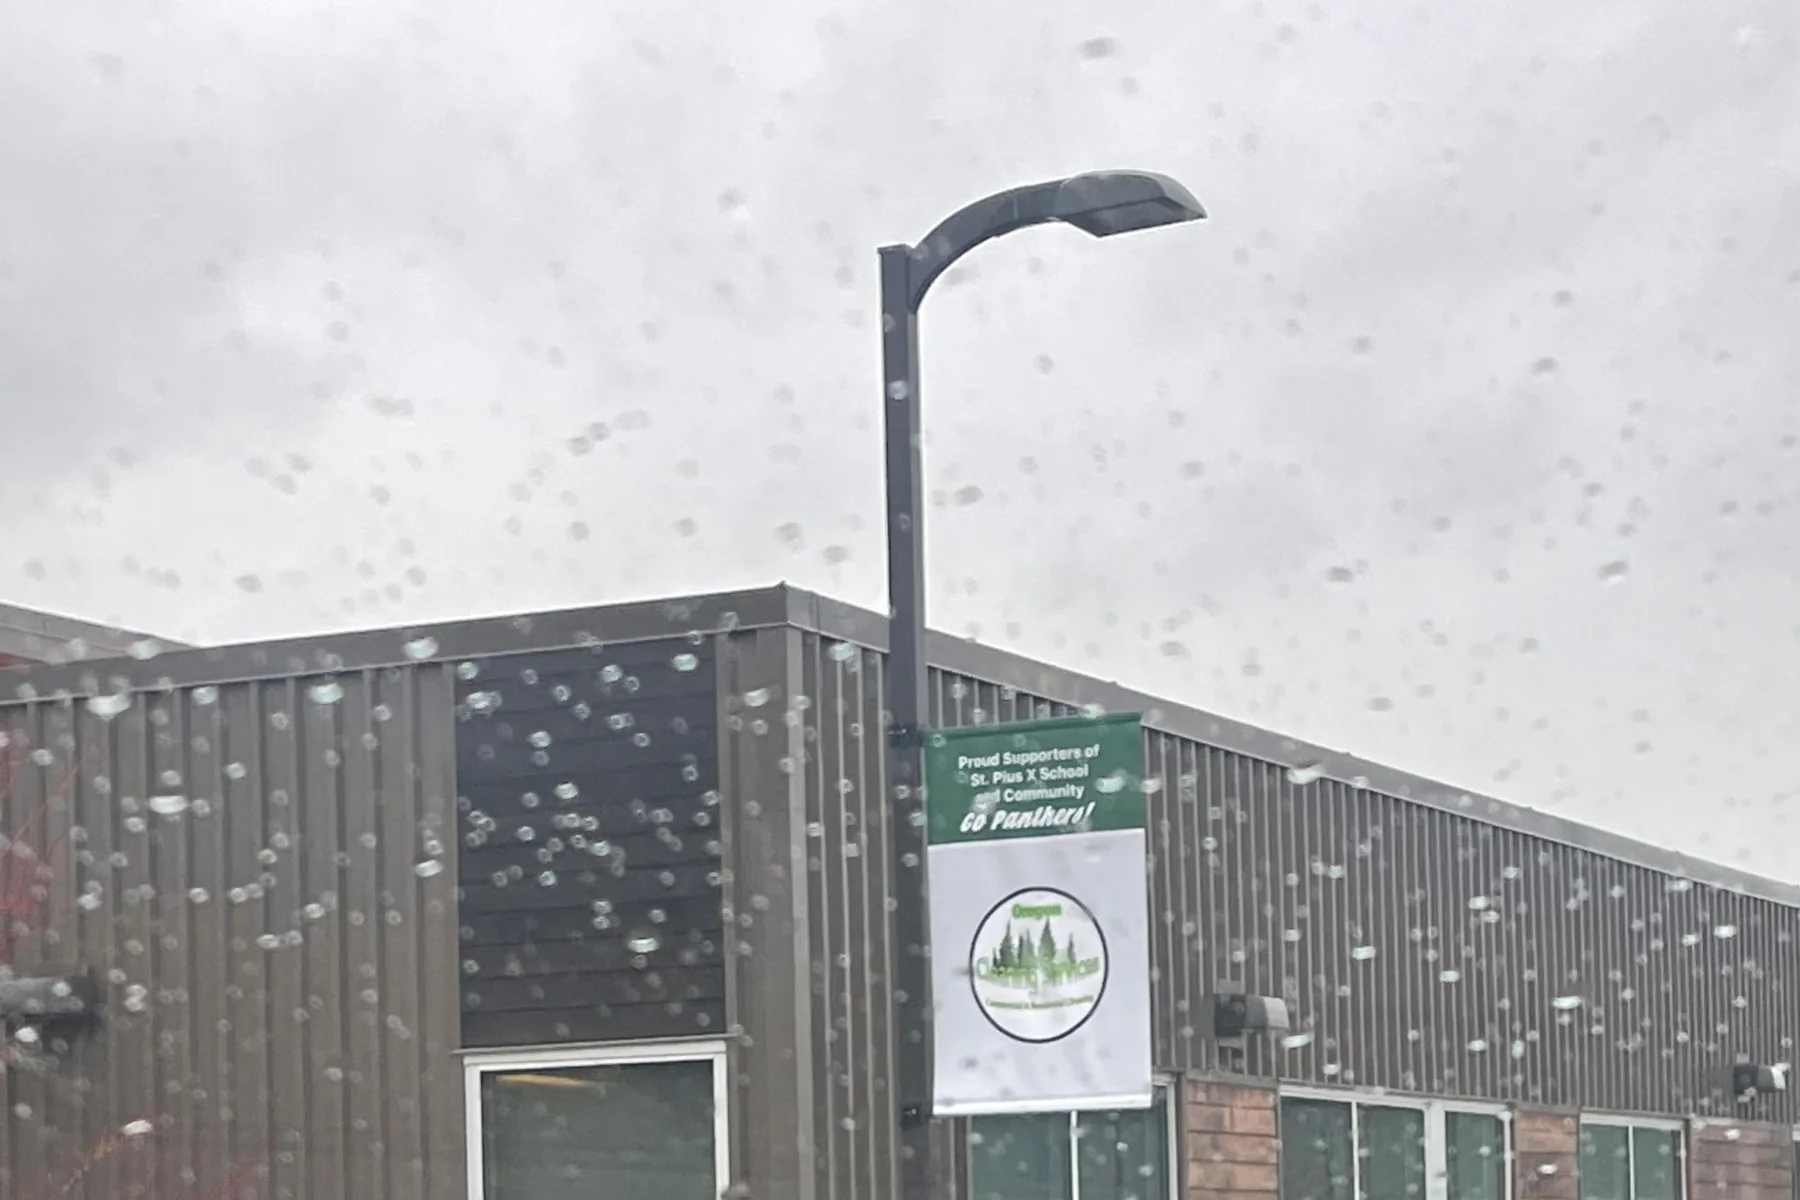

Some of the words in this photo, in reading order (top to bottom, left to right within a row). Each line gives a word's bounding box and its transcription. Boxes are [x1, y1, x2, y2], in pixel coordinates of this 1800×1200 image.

[958, 753, 1000, 768] Proud
[1002, 748, 1082, 766] Supporters
[1085, 743, 1101, 757] of
[970, 773, 990, 787] St.
[992, 771, 1024, 785] Pius
[1026, 768, 1038, 781] X
[1039, 764, 1089, 780] School
[975, 789, 1001, 803] and
[1003, 784, 1085, 802] Community
